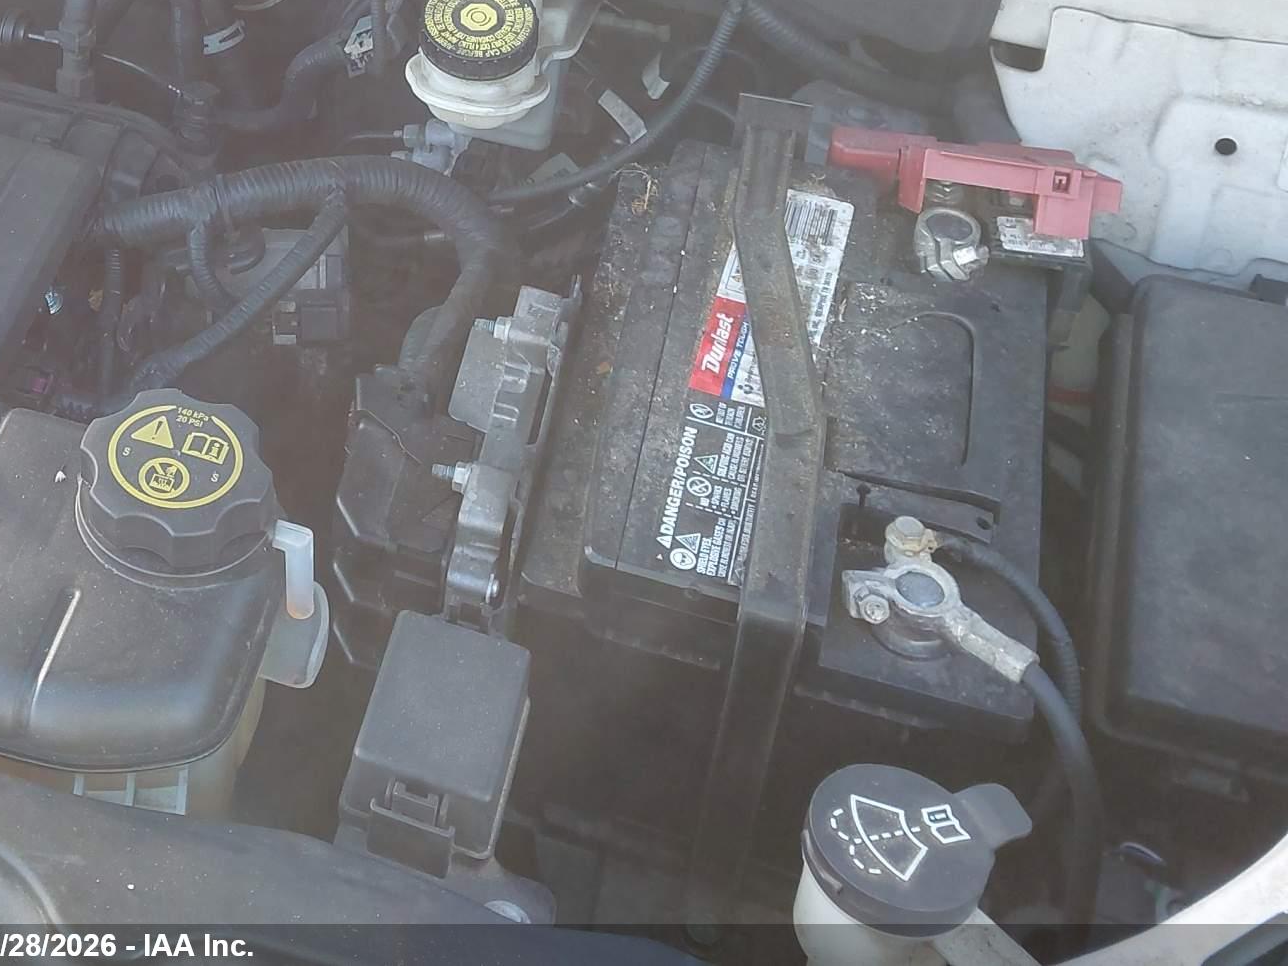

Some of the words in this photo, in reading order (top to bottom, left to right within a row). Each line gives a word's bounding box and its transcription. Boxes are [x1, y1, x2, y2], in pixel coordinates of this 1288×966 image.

[484, 48, 501, 57] CAP
[736, 322, 749, 349] TOUGH
[176, 415, 187, 423] 20
[188, 418, 203, 427] PSI
[178, 407, 192, 416] 140
[193, 411, 209, 421] kPa
[661, 426, 698, 537] DANGER/POISON
[719, 487, 732, 508] FLAMES
[712, 525, 724, 545] GASES
[706, 544, 721, 576] EXPLOSIVE
